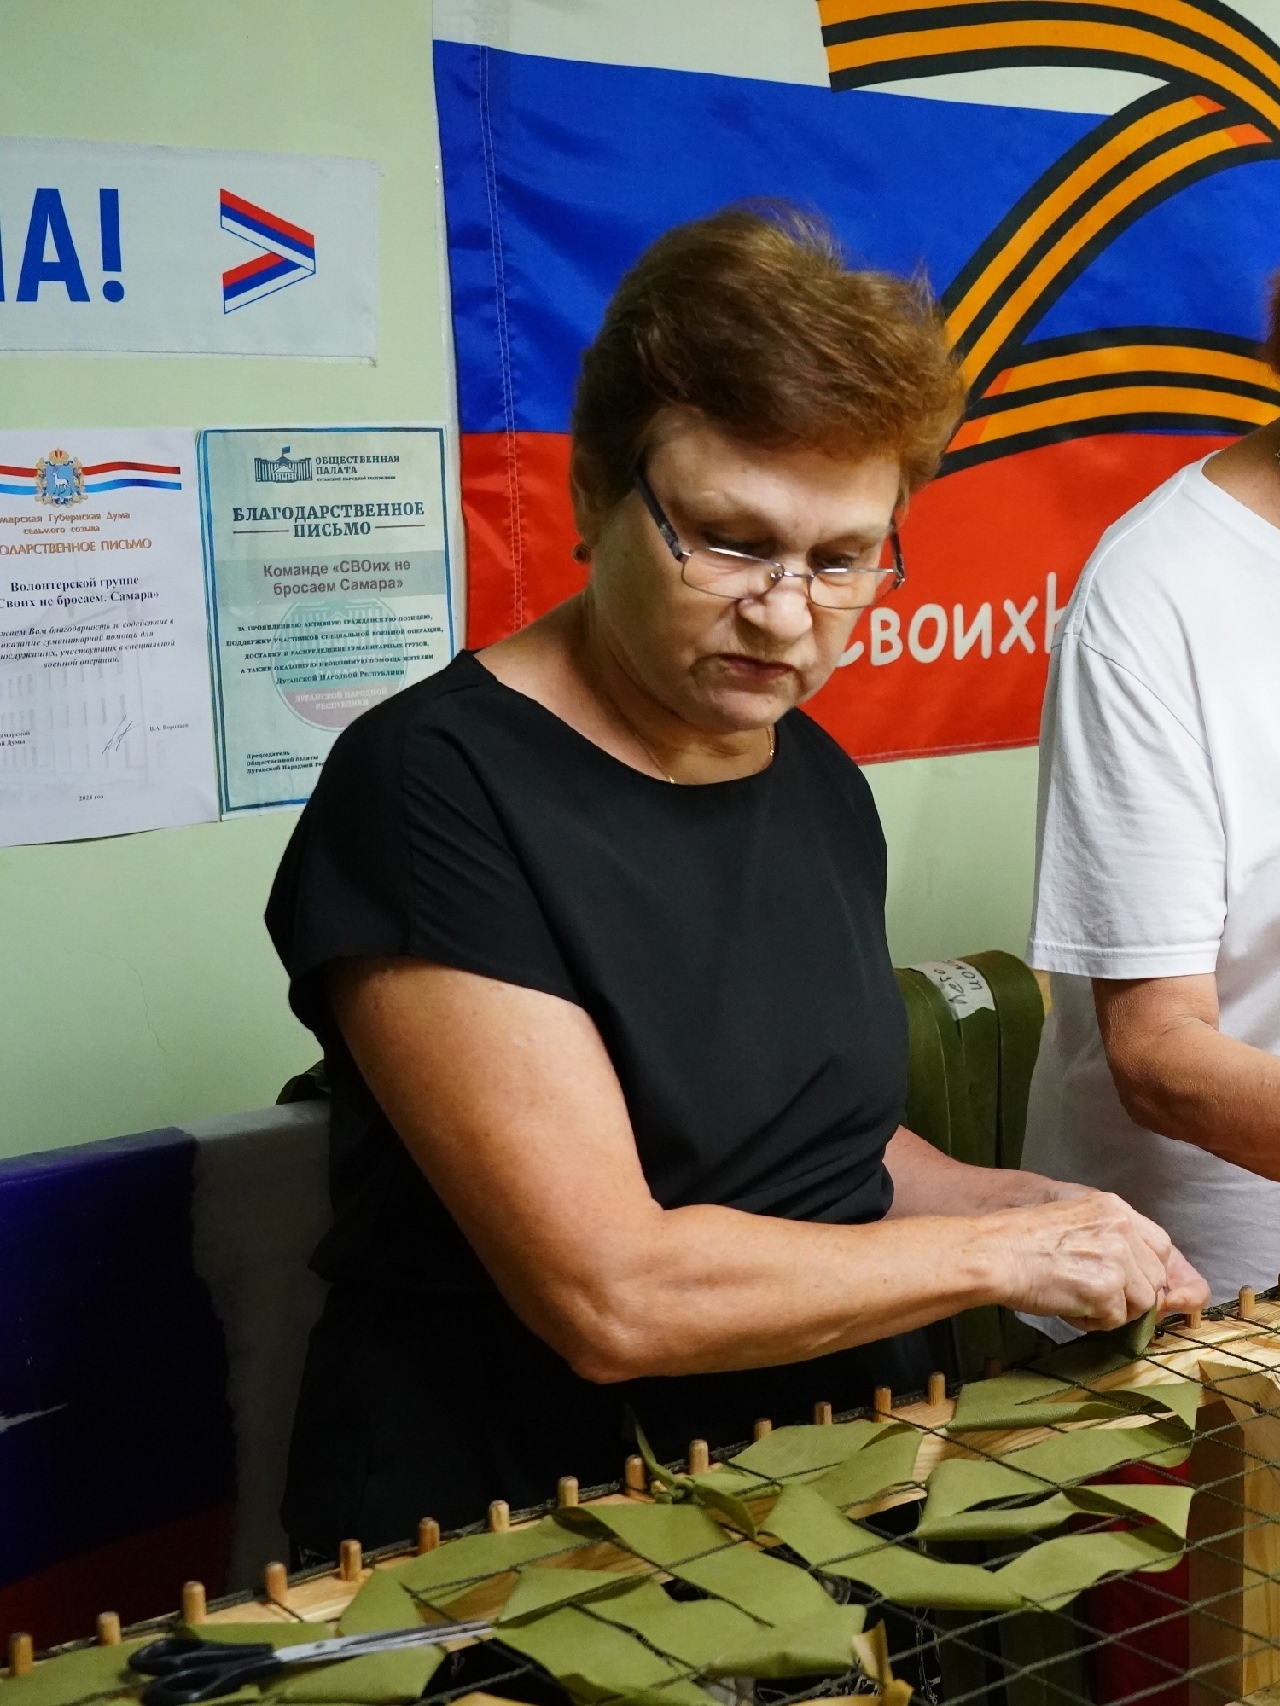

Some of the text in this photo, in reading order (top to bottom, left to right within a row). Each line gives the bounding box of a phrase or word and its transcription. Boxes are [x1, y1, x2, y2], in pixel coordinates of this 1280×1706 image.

[0, 188, 125, 302] А!
[315, 455, 400, 466] ОБЩЕСТВЕННАЯ
[316, 466, 358, 475] ПАЛАТА
[48, 512, 101, 524] Губернская
[106, 511, 131, 521] Дума
[232, 501, 425, 523] БЛАГОДАРСТВЕННОЕ
[23, 525, 101, 535] седьмого созыва
[293, 521, 372, 538] ПИСЬМО
[0, 538, 152, 555] ОДАРСТВЕННОЕ ПИСЬМО
[263, 559, 411, 578] Команде «СВОих не
[10, 576, 139, 592] Волонтерской группе
[273, 578, 404, 598] бросаем Самара»
[40, 598, 54, 607] не
[110, 591, 159, 602] Самара»
